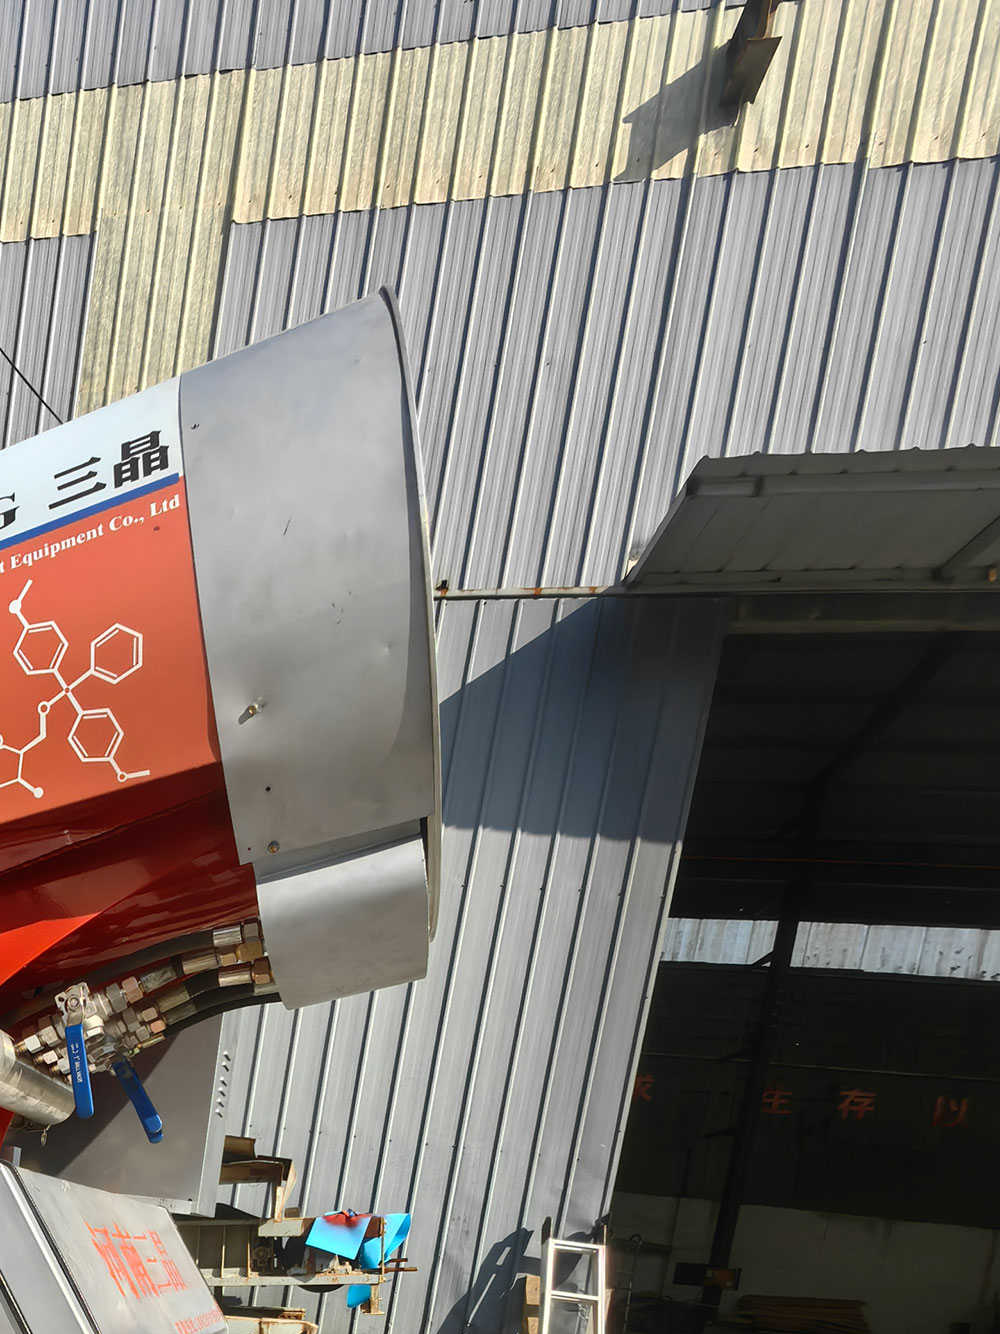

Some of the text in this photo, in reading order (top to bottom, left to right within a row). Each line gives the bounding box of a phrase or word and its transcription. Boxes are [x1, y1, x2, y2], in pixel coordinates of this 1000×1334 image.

[48, 430, 170, 511] 三晶
[10, 522, 104, 569] Equipment
[149, 493, 181, 518] Ltd
